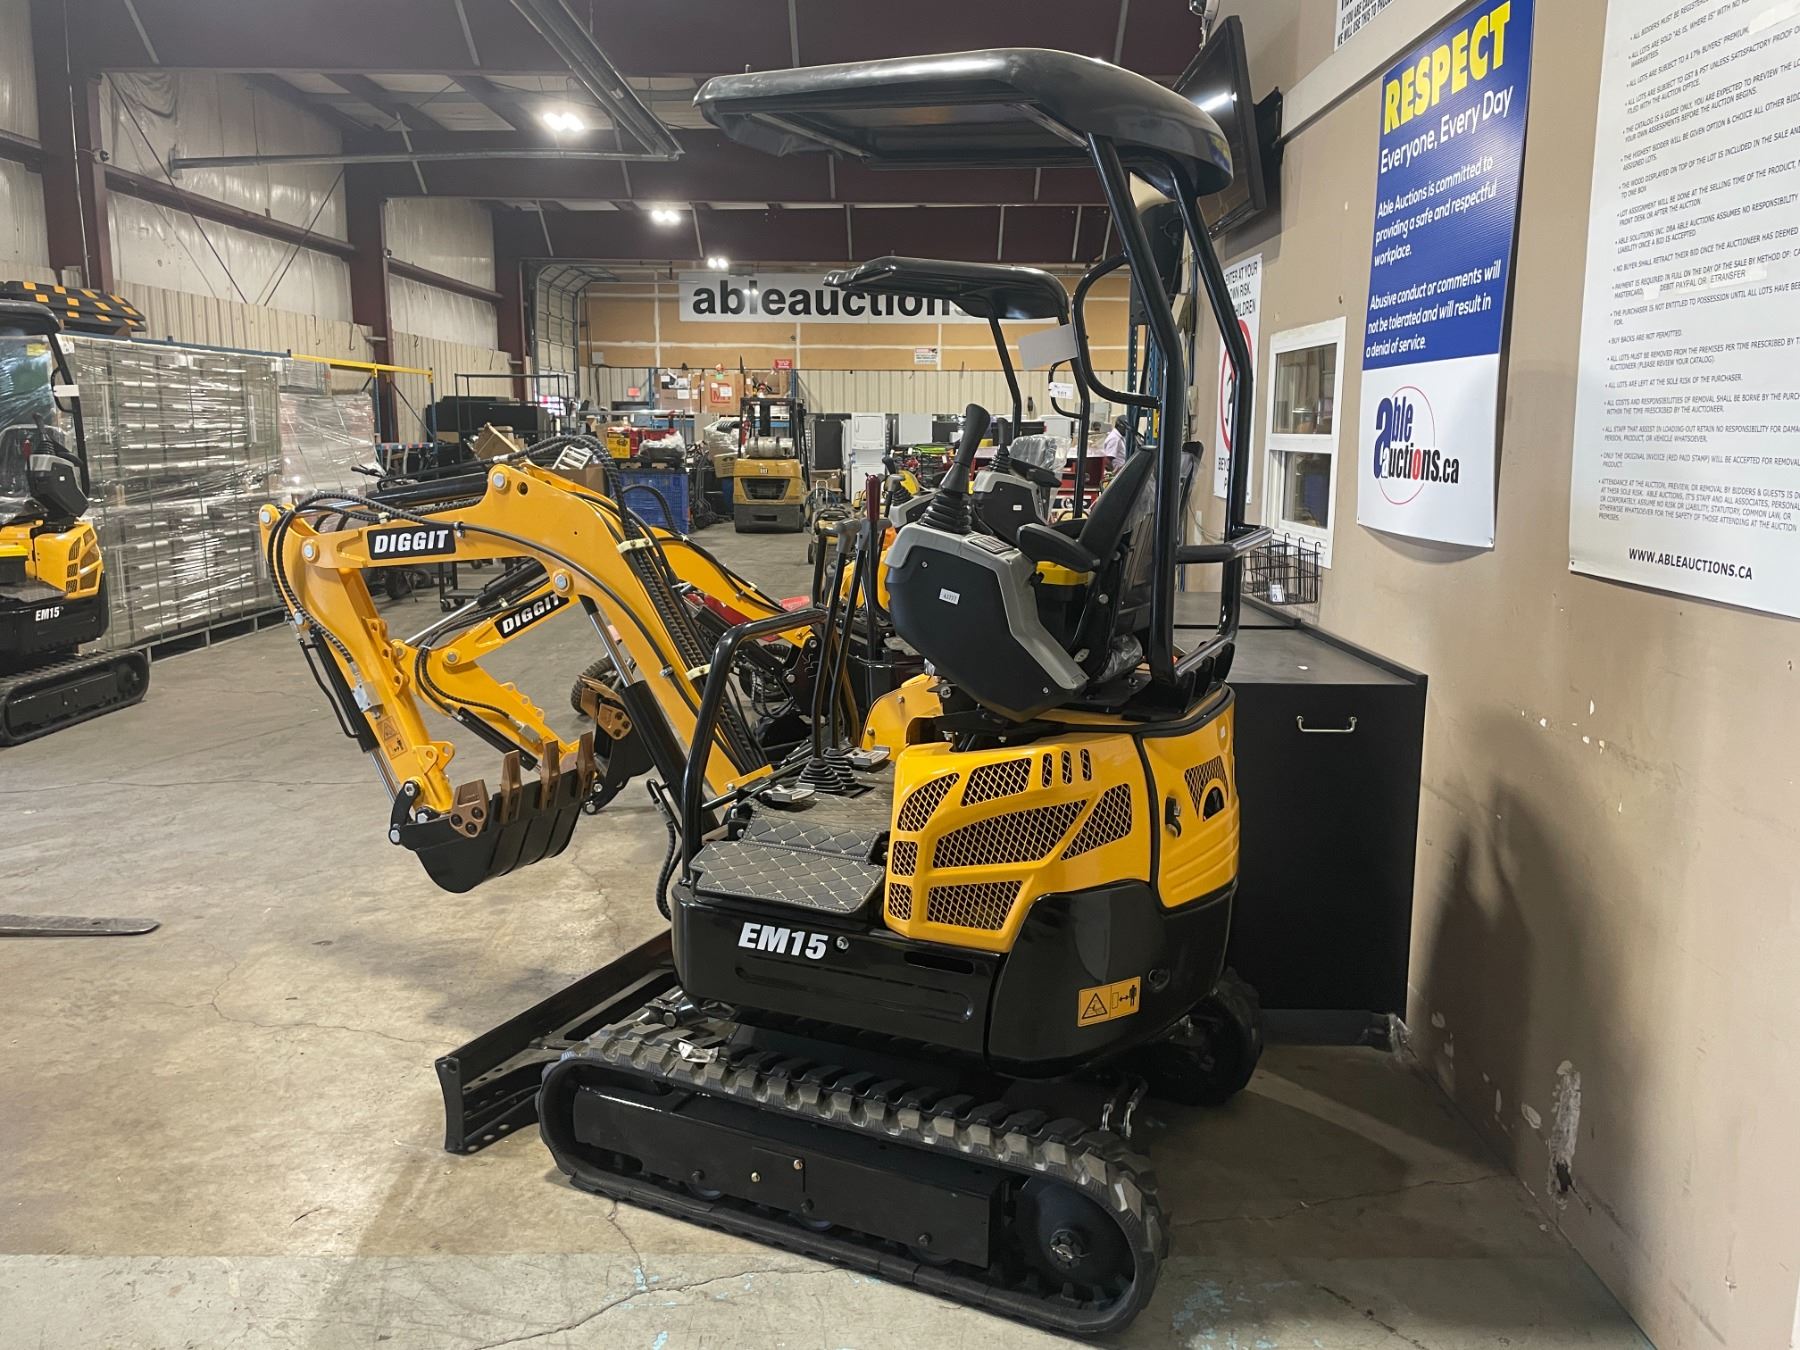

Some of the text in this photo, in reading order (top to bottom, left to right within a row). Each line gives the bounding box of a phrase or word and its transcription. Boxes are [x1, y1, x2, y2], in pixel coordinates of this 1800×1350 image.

[1730, 37, 1771, 60] SATISFACTORY
[1772, 28, 1793, 43] PROOF
[1384, 1, 1510, 135] RESPECT
[1716, 81, 1742, 97] EXPECTED
[1752, 67, 1778, 83] PREVIEW
[1779, 61, 1791, 73] THE
[1706, 118, 1725, 131] OPTION
[1731, 109, 1752, 123] CHOICE
[1753, 106, 1763, 115] ALL
[1765, 97, 1784, 110] OTHER
[1710, 94, 1734, 109] AUCTION
[1380, 85, 1514, 174] Everyone, Every Day
[1725, 141, 1752, 156] INCLUDED
[1753, 138, 1760, 147] IN
[1761, 134, 1772, 144] THE
[1773, 129, 1788, 140] SALE
[1746, 172, 1754, 180] OF
[1755, 168, 1766, 178] THE
[1377, 155, 1493, 220] Able Auctions is committed to
[1376, 180, 1498, 246] providing a safe and respectful
[1716, 207, 1740, 220] ASSUMES
[1742, 205, 1750, 213] NO
[1752, 193, 1798, 211] RESPONSIBILITY
[1715, 242, 1725, 250] THE
[1726, 234, 1760, 248] AUCTIONEER
[1761, 232, 1773, 240] HAS
[1774, 226, 1798, 238] DEEMED
[1374, 242, 1412, 266] workplace.
[1722, 261, 1732, 269] THE
[1733, 258, 1747, 267] SALE
[1756, 252, 1780, 263] METHOD
[1370, 259, 1501, 311] Abusive conduct or comments will
[1710, 269, 1746, 282] ETRANSFER
[1730, 290, 1746, 298] UNTIL
[1758, 286, 1773, 294] LOTS
[1774, 283, 1789, 292] HAVE
[1235, 298, 1256, 317] HILDREN
[1368, 294, 1492, 334] not be tolerated and will result in
[1366, 334, 1426, 358] a denial of service.
[1750, 338, 1786, 348] PRESCRIBED
[1742, 509, 1766, 517] COMMON
[1770, 522, 1797, 531] AUCTION
[374, 530, 448, 554] DIGGIT
[1629, 548, 1753, 580] WWW.ABLEAUCTIONS.CA
[36, 606, 60, 622] EM15
[502, 594, 560, 634] DIGGIT
[738, 922, 829, 960] EM15
